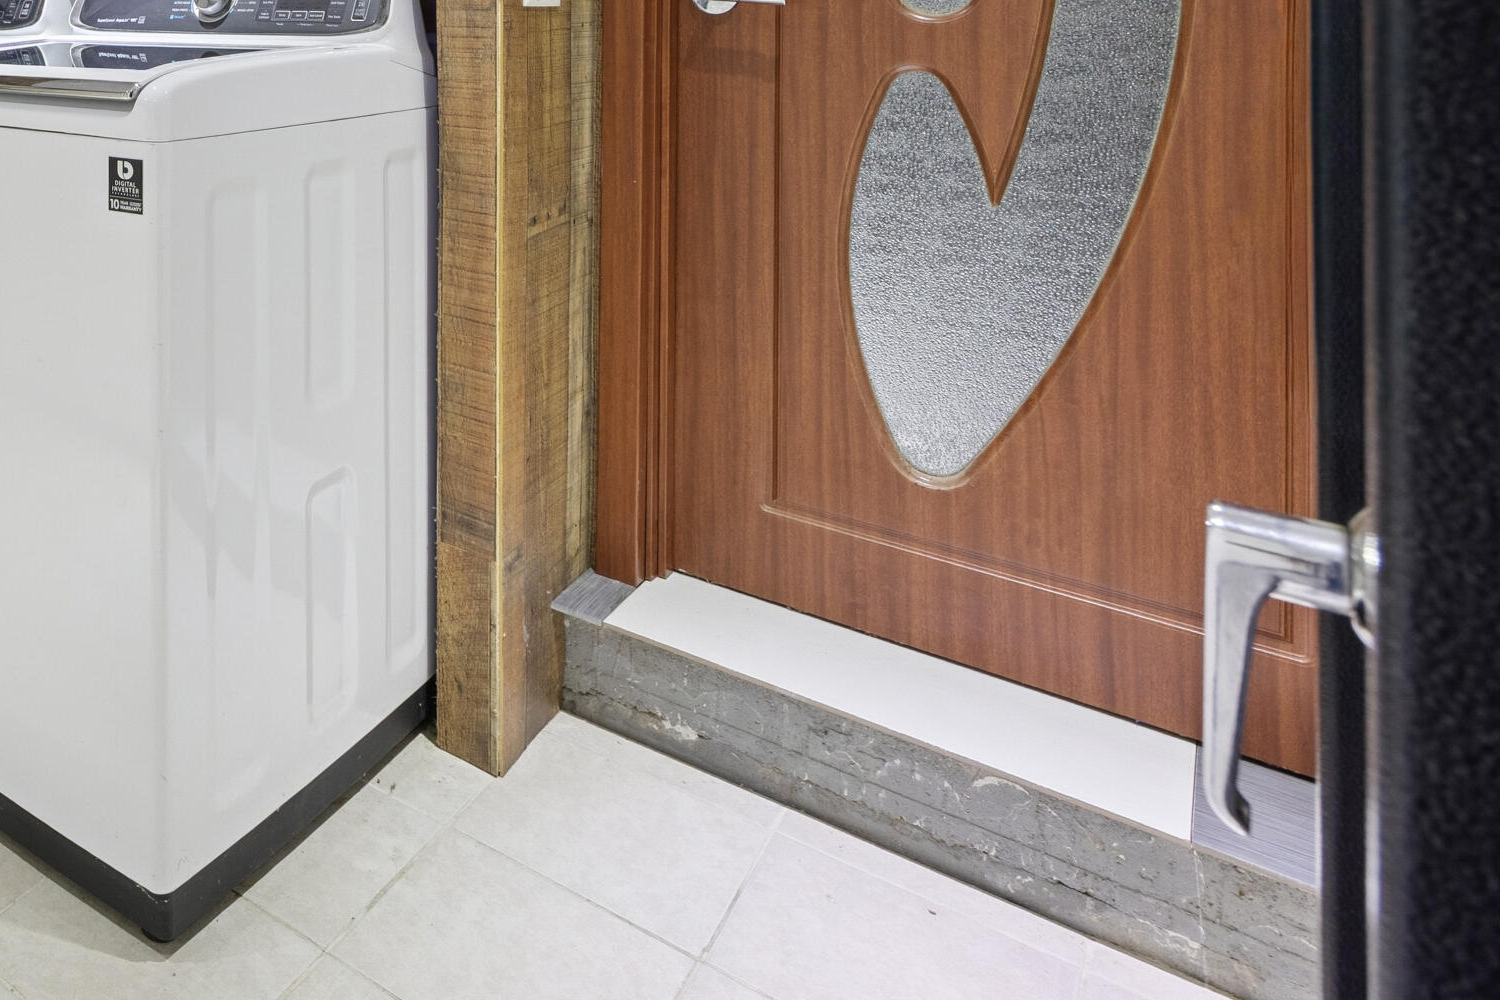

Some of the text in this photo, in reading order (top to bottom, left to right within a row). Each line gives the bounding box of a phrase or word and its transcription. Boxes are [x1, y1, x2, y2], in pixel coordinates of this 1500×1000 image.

[114, 180, 136, 188] DIGITAL
[111, 186, 140, 194] INVERTER
[109, 198, 120, 210] 10
